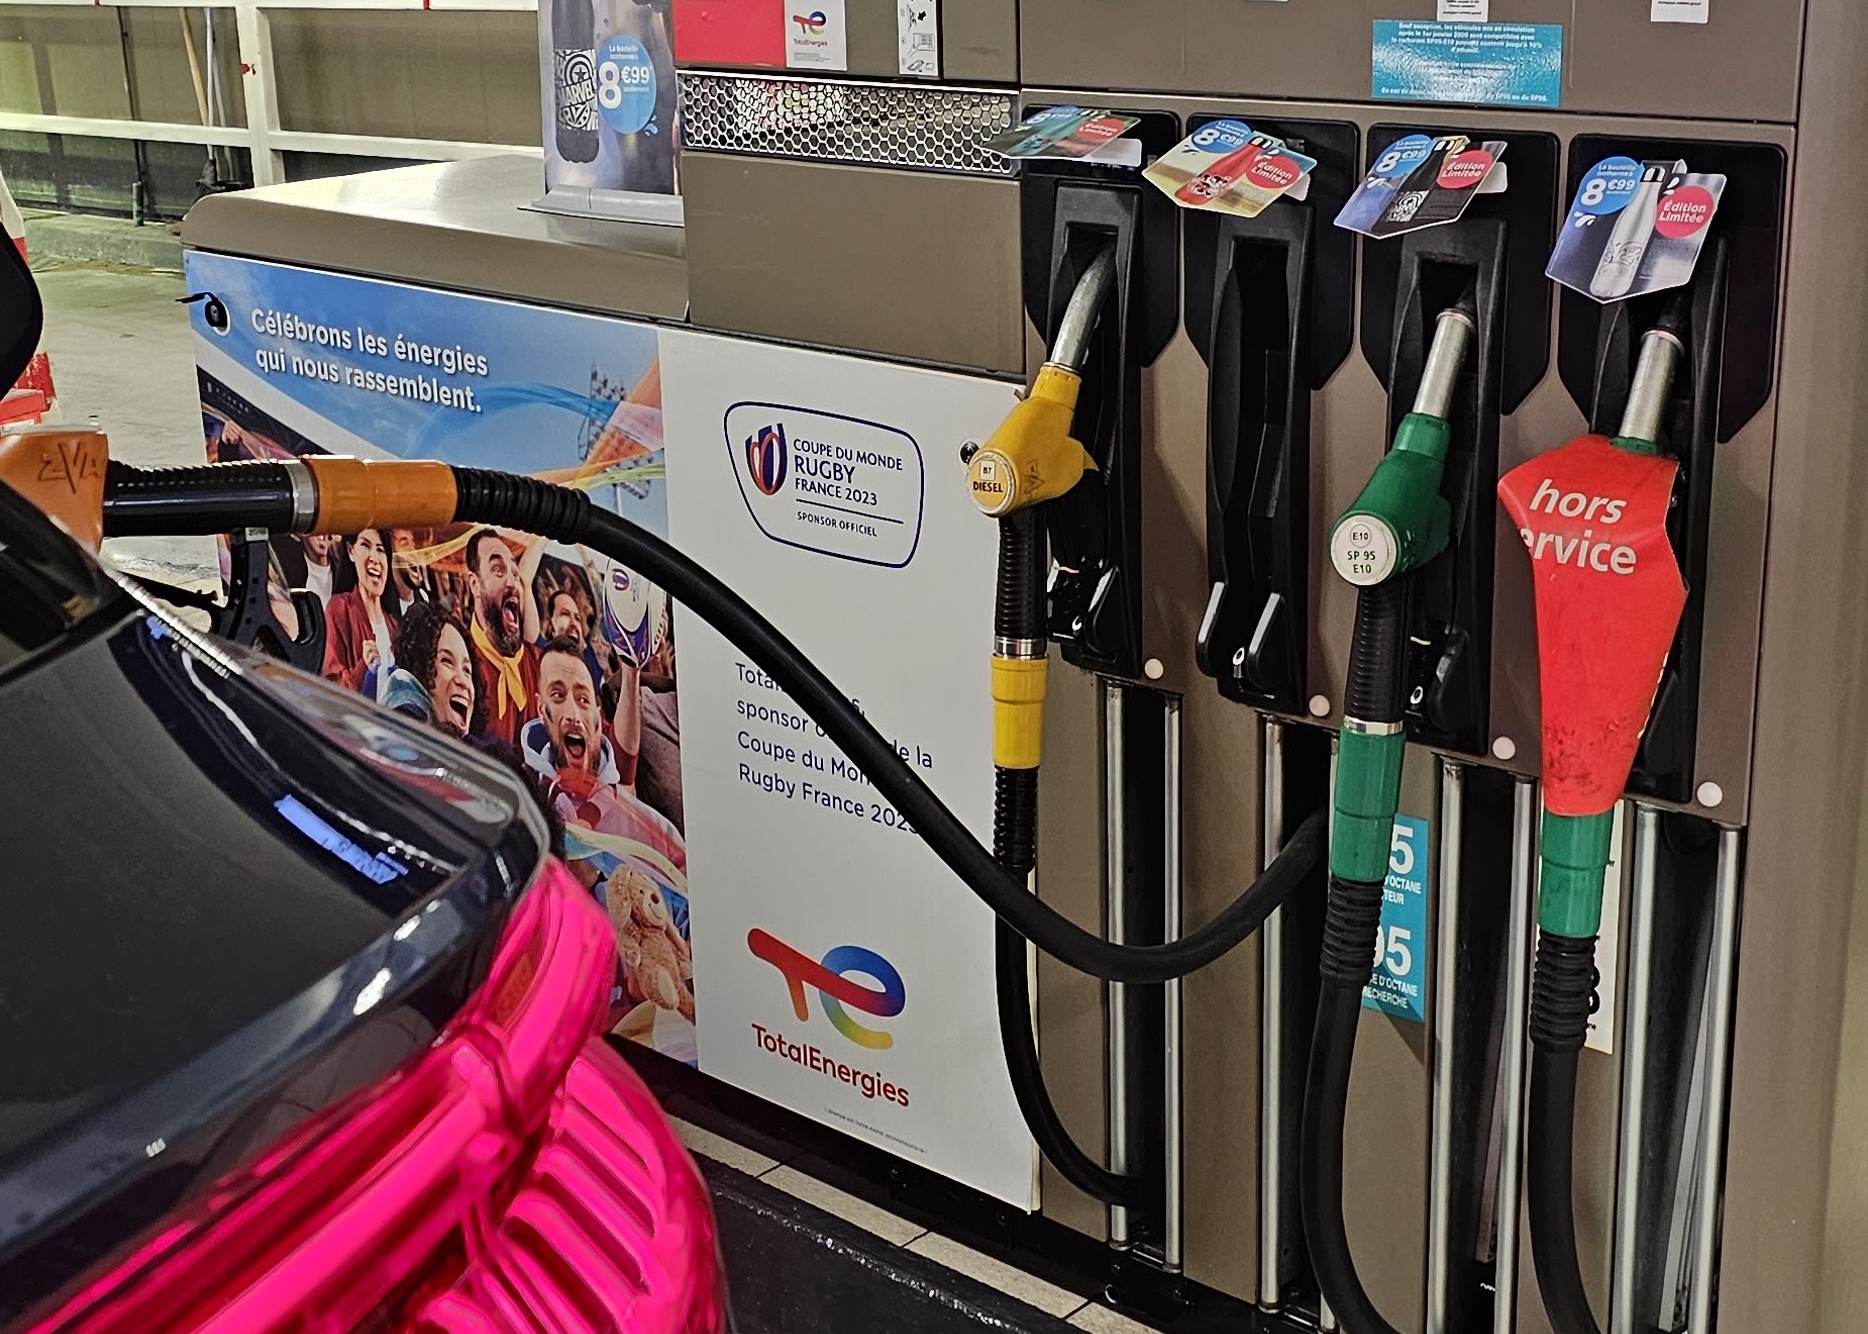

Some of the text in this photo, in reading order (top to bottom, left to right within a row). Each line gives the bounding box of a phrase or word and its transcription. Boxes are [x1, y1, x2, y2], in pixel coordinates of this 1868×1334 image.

[560, 77, 595, 108] MARVEL
[598, 61, 622, 109] 8
[1193, 129, 1220, 146] 8
[1220, 133, 1244, 146] €99
[1257, 161, 1293, 180] Édition
[1376, 149, 1427, 173] 8 €99
[1441, 169, 1481, 178] Limitée
[1446, 161, 1485, 171] Édition
[1251, 166, 1288, 185] Limitée
[1580, 178, 1636, 206] 8 €99
[1658, 211, 1704, 224] Limitée
[1663, 199, 1707, 213] Édition
[251, 308, 488, 376] Célébrons les énergies
[255, 347, 482, 413] qui nous rassemblent.
[793, 438, 903, 471] COUPE DU MONDE
[794, 454, 856, 484] RUGBY
[795, 477, 878, 506] FRANCE 2023
[973, 481, 1004, 493] DIESEL
[1529, 478, 1627, 524] hors
[797, 511, 877, 537] SPONSOR OFFICIEL
[1352, 532, 1369, 540] E10
[1347, 551, 1376, 560] SP 95
[1520, 528, 1637, 575] ervice
[1353, 564, 1372, 574] E10
[737, 700, 809, 732] sponsor
[916, 745, 933, 769] la
[737, 730, 796, 762] Coupe
[802, 749, 825, 771] du
[831, 757, 870, 786] Mon
[739, 763, 796, 799] Rugby
[802, 782, 864, 817] France
[1379, 977, 1418, 997] D'OCTANE
[751, 1022, 910, 1107] TotalEnergies
